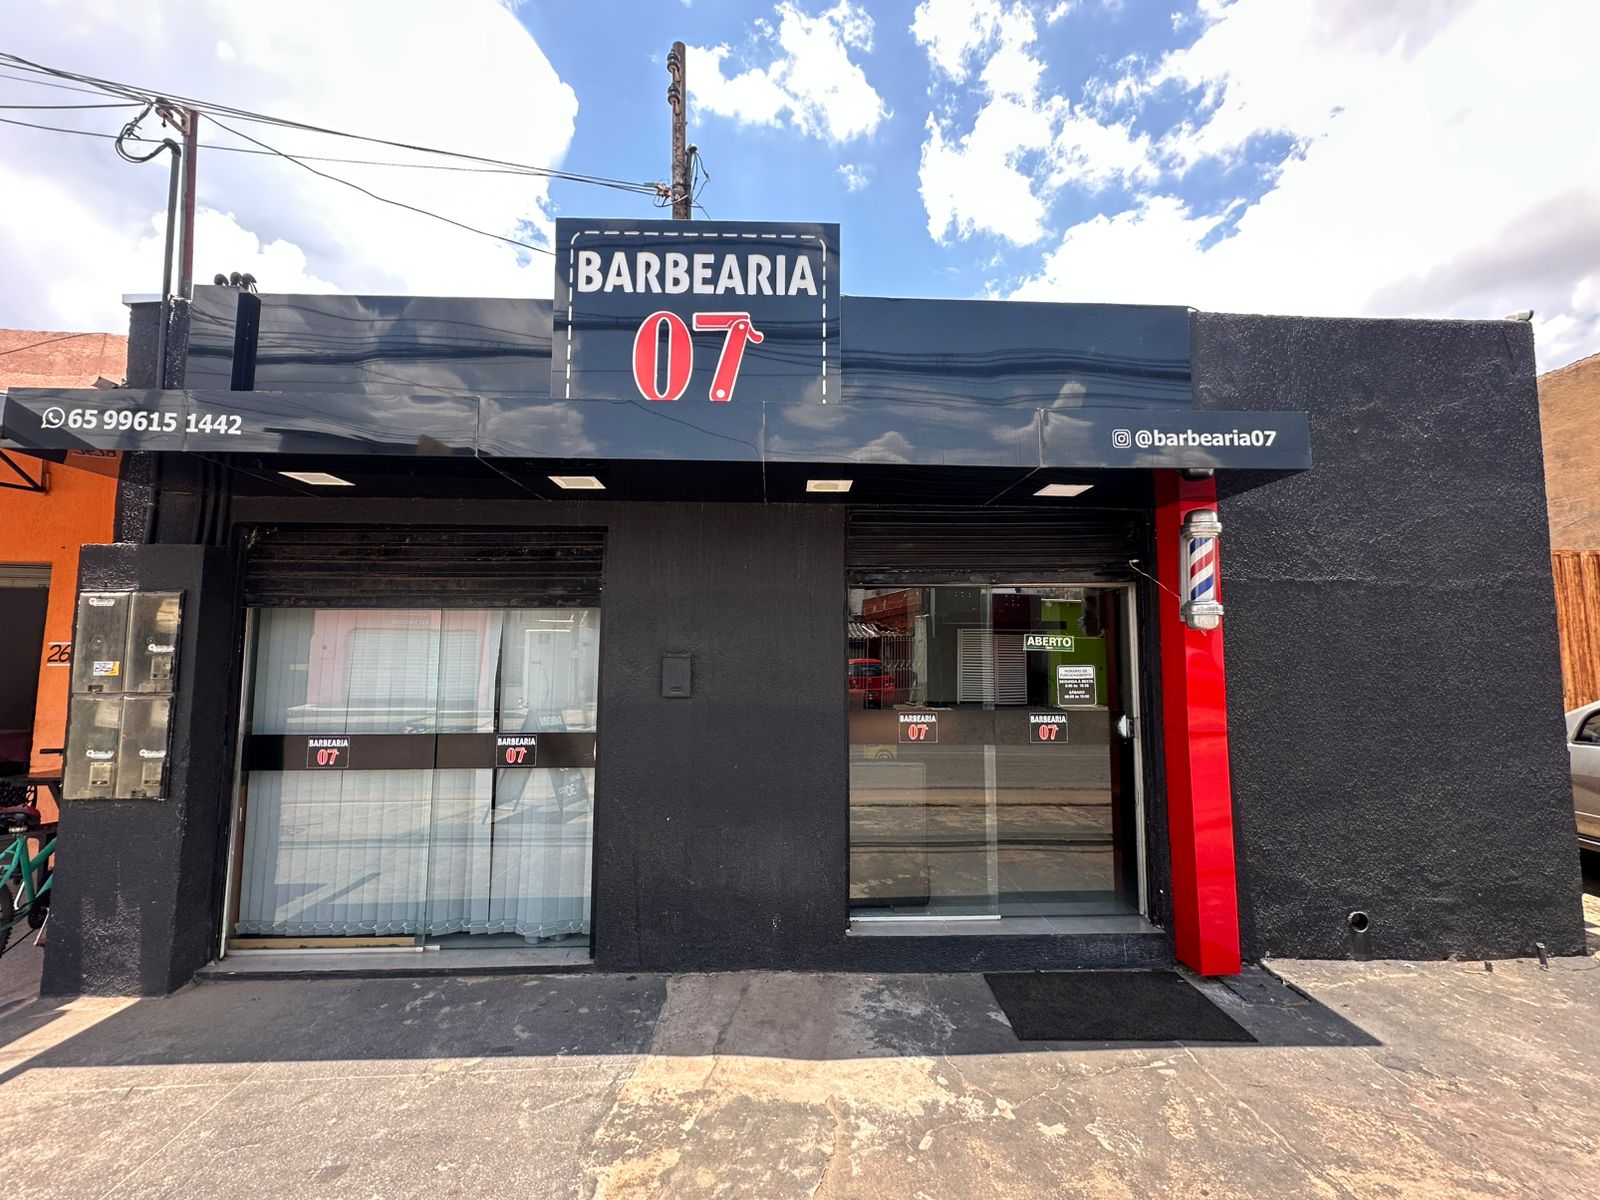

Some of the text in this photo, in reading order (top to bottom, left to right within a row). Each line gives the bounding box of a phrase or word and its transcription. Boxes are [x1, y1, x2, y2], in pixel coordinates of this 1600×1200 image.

[577, 250, 818, 296] BARBEARIA
[632, 310, 764, 402] 07
[67, 409, 242, 435] 65 99615 1442
[1135, 429, 1277, 448] @barbearia07
[1026, 636, 1072, 647] ABERTO
[900, 715, 937, 723] BARBEARIA
[1030, 715, 1067, 723] BARBEARIA
[908, 724, 928, 740] 07
[1038, 724, 1059, 740] 07
[308, 739, 349, 747] BARBEARIA
[497, 737, 536, 746] BARBEARIA
[317, 748, 339, 765] 07
[505, 747, 527, 764] 07
